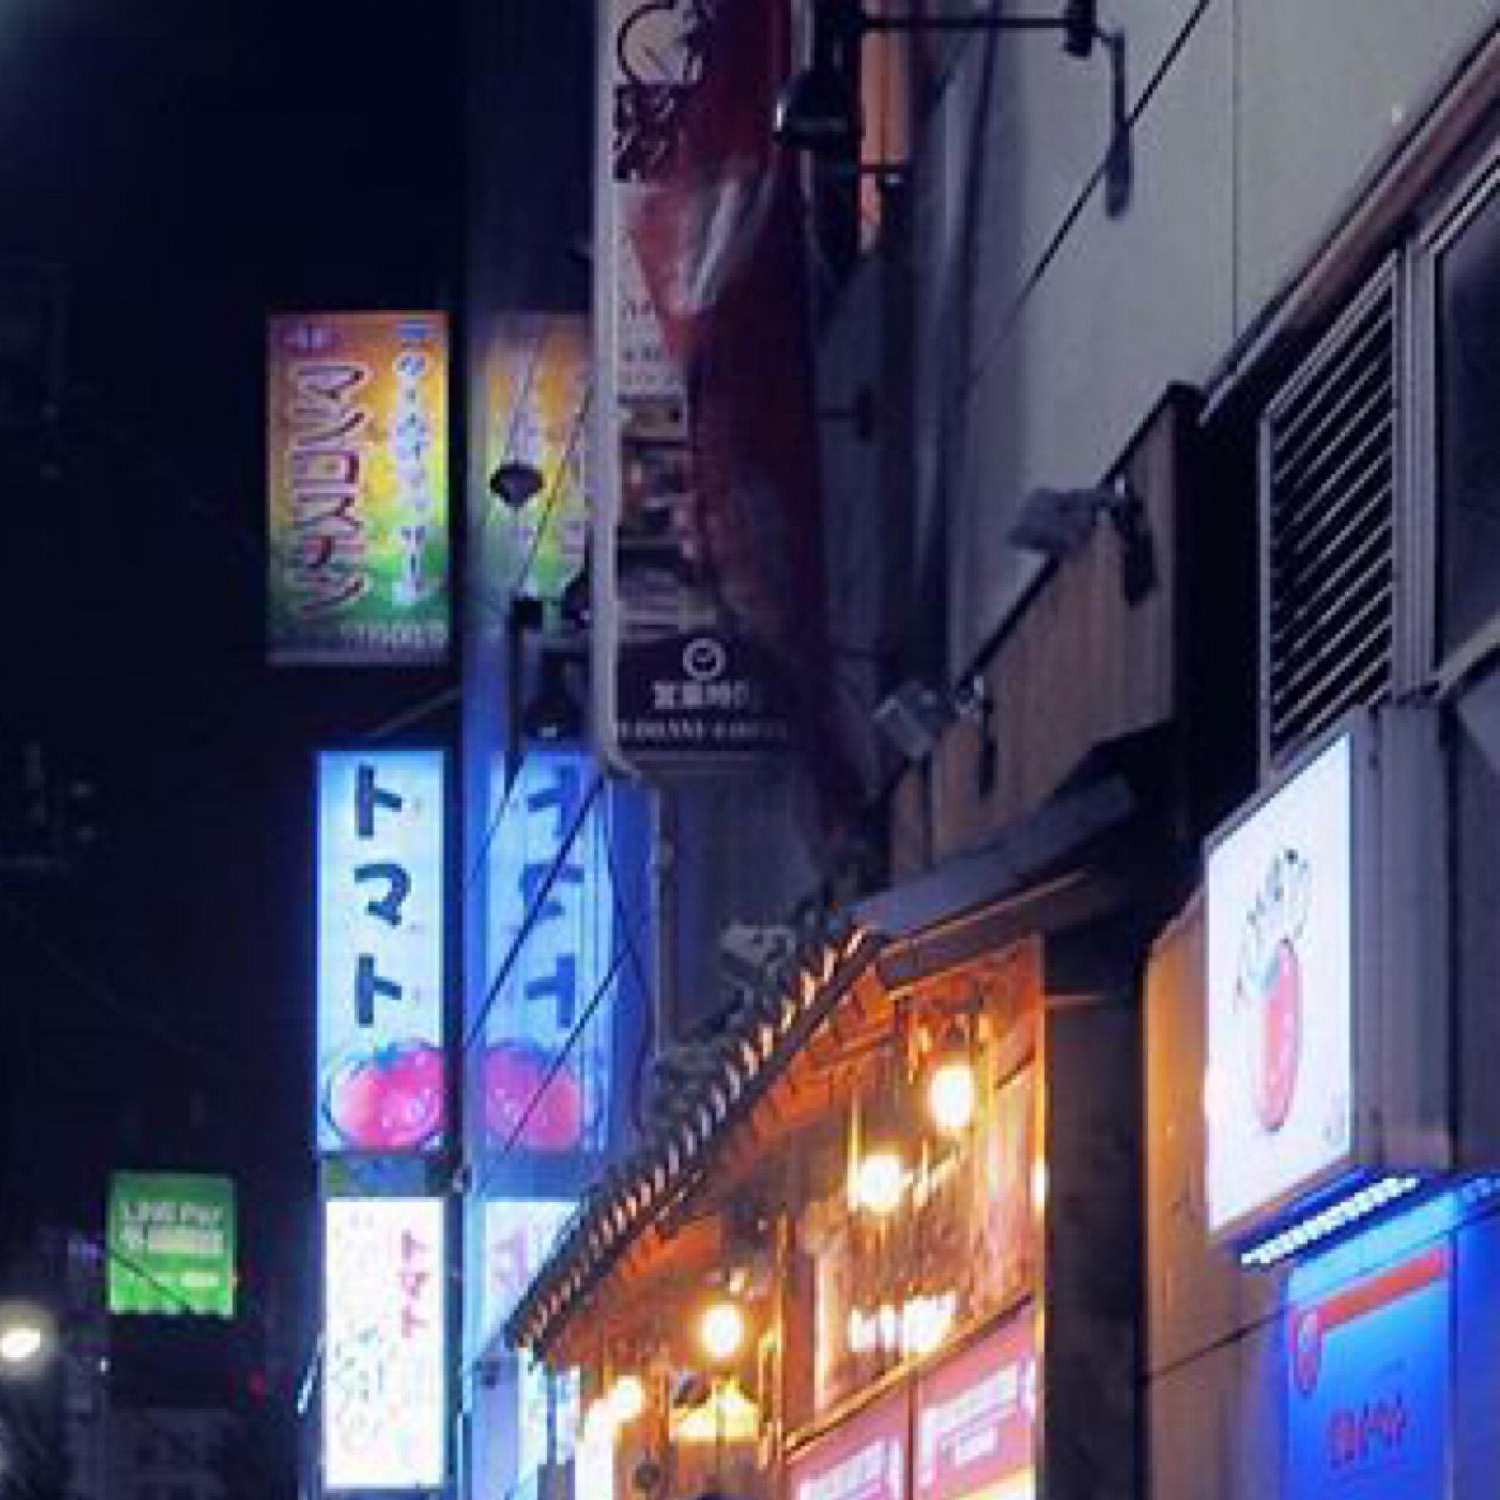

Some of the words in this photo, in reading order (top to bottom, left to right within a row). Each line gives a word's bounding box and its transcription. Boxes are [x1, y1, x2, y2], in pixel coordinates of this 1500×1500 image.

[354, 765, 411, 1028] トマト
[397, 1228, 430, 1339] トマト
